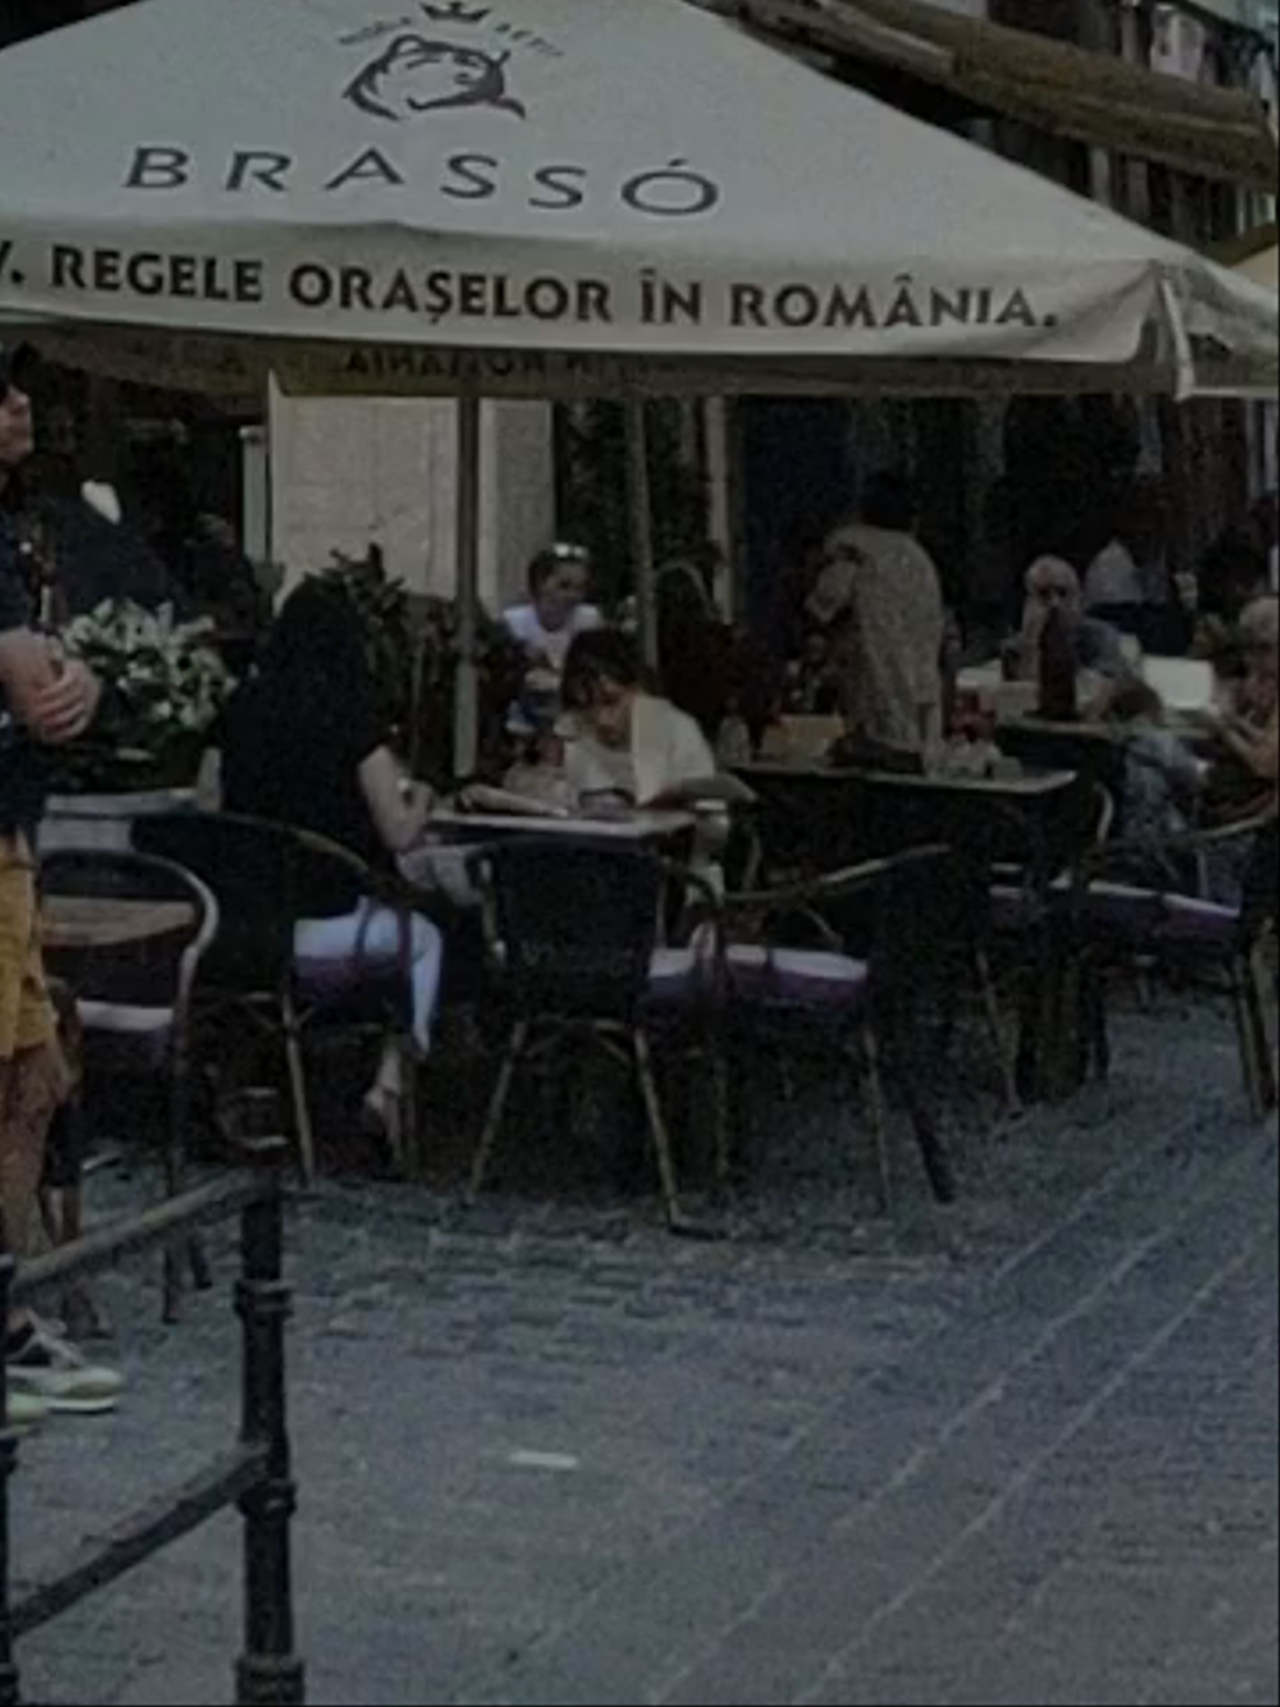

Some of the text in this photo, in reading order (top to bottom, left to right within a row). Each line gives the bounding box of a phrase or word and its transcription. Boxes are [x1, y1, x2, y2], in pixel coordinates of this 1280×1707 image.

[123, 142, 721, 218] BRASSÓ
[50, 244, 263, 303] REGELE
[289, 263, 612, 325] ORAȘELOR
[639, 268, 701, 324] ÎN
[730, 274, 1059, 329] ROMÂNIA.
